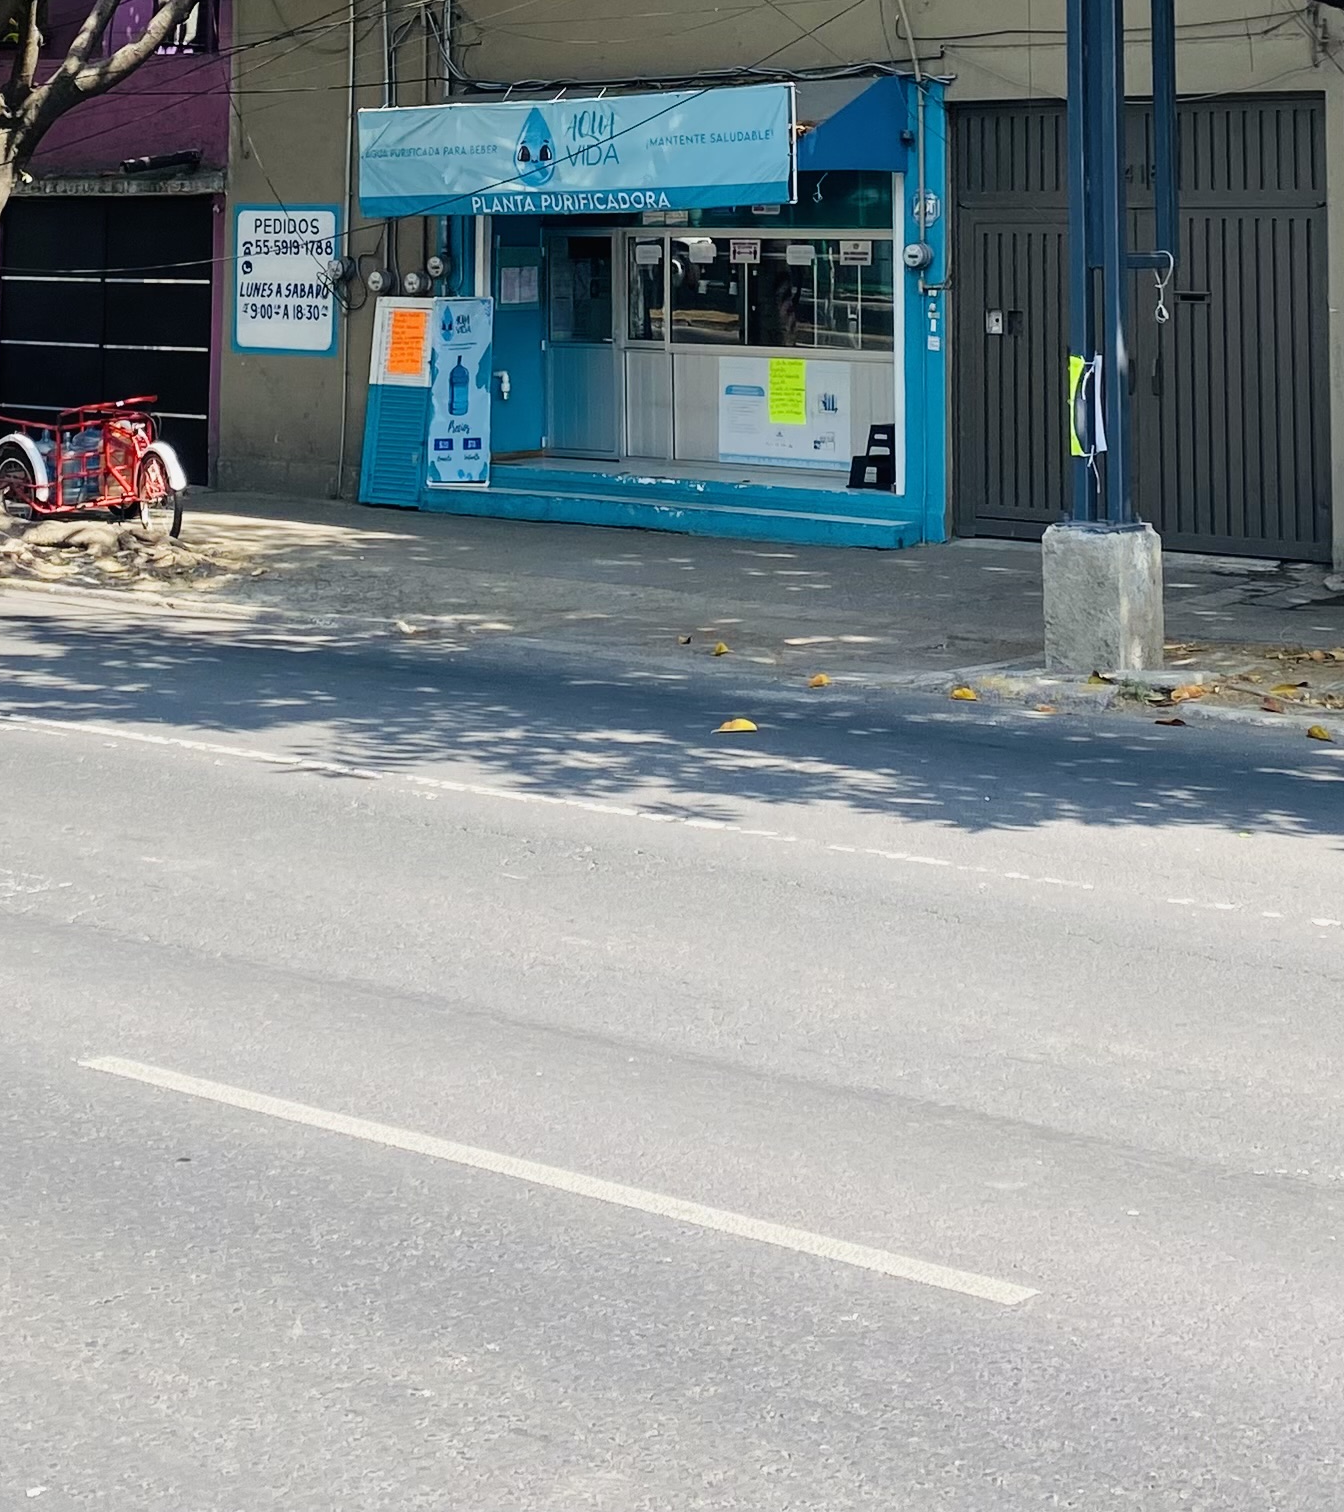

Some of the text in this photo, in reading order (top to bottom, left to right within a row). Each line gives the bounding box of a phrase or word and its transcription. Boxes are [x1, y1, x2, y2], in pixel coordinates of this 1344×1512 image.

[390, 146, 440, 158] PURIFICADA
[443, 146, 467, 156] PARA
[470, 144, 498, 155] BEBER
[566, 143, 620, 167] VIDA
[471, 191, 672, 214] PLANTA PURIFICADORA
[254, 218, 320, 235] PEDIDOS
[239, 282, 330, 300] LUNES A SABADO
[293, 304, 320, 321] 18:30
